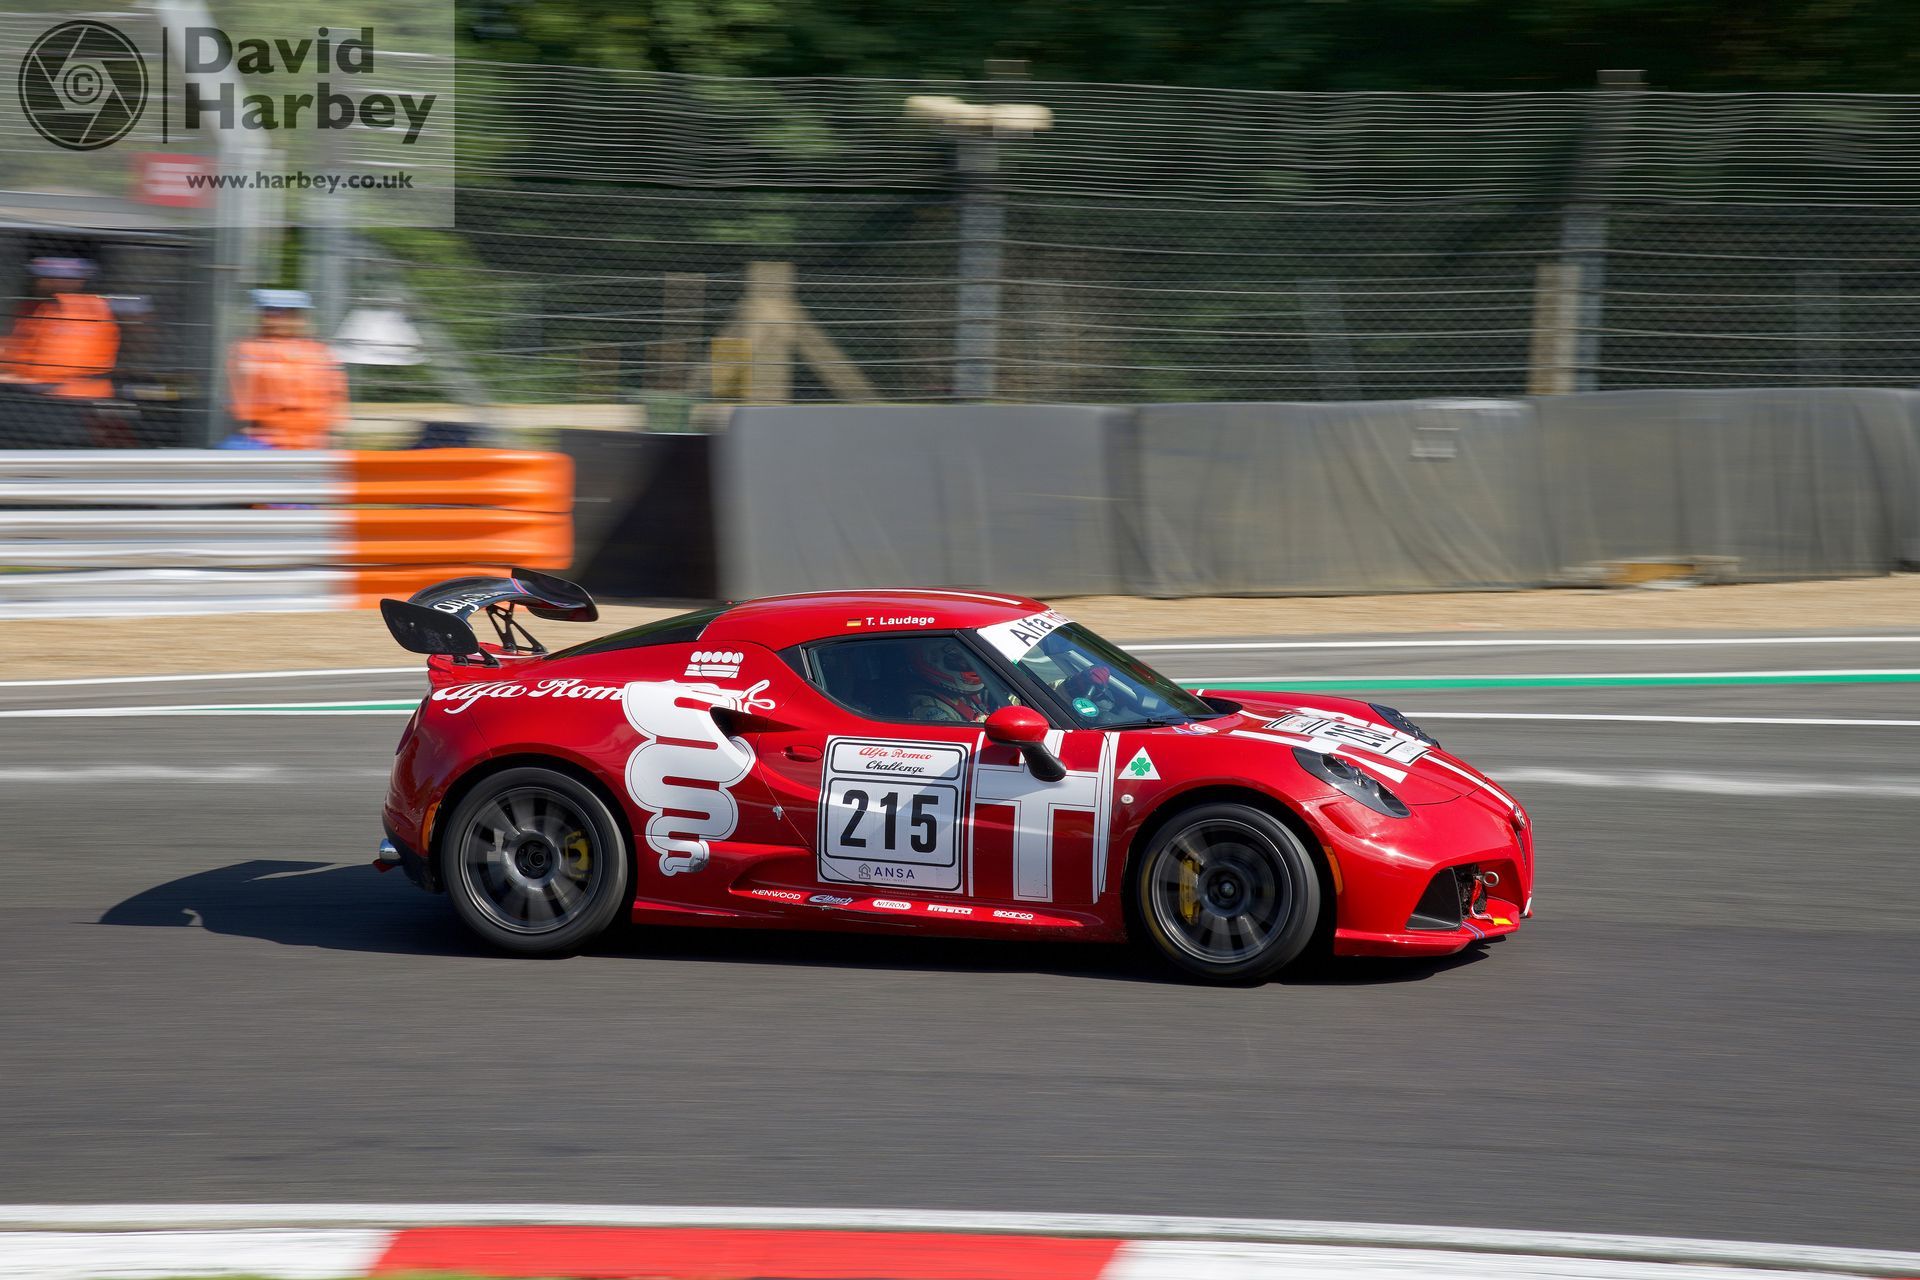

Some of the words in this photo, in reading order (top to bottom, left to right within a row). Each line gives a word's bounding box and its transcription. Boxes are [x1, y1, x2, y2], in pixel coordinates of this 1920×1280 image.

[865, 617, 876, 626] T.
[880, 616, 935, 626] Laudage
[1009, 617, 1055, 647] Alfa
[432, 679, 527, 714] Alfa
[859, 747, 888, 758] Alfa
[891, 749, 932, 760] Romeo
[865, 760, 925, 774] Challenge
[840, 789, 939, 853] 215
[874, 866, 915, 879] ANSA
[751, 888, 801, 900] KENWOOD
[876, 901, 907, 909] NITRON
